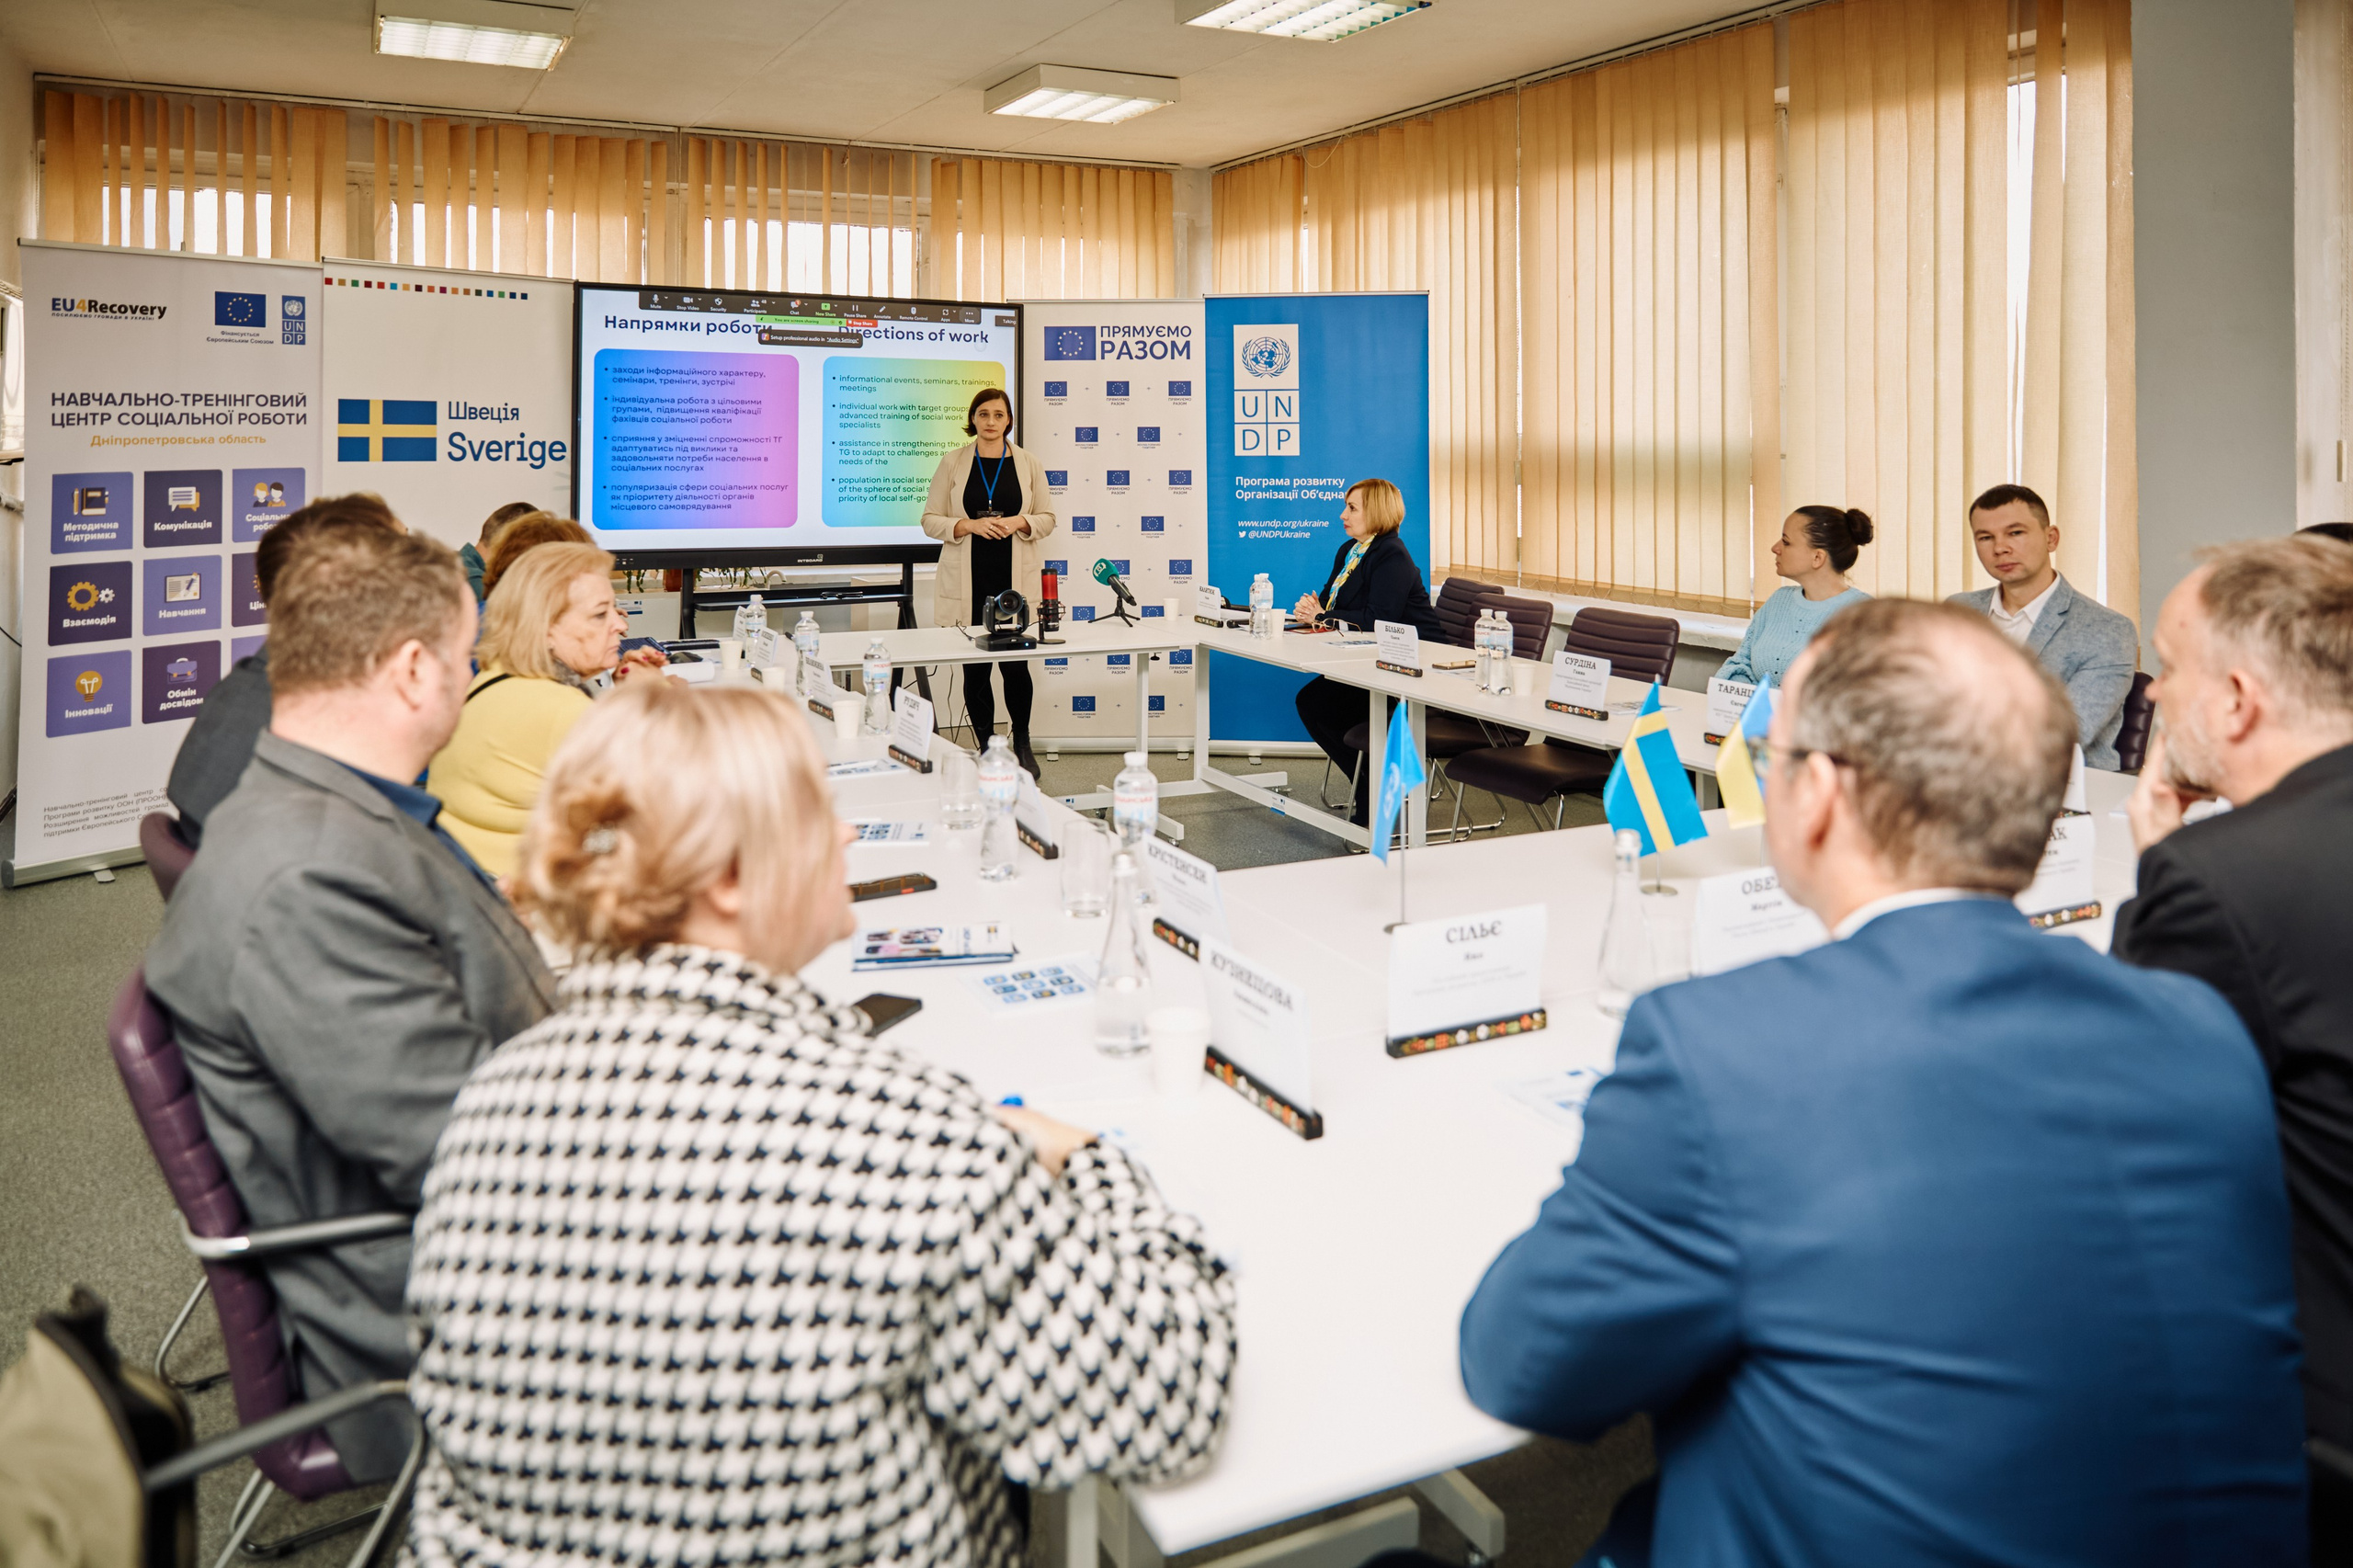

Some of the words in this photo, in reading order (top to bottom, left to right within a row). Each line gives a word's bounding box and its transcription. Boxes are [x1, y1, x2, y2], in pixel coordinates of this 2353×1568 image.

[51, 298, 167, 319] EU4Recovery
[605, 315, 700, 333] Напрямки
[928, 328, 945, 342] of
[949, 331, 989, 344] work
[1100, 325, 1192, 338] ПРЯМУЄМО
[1100, 340, 1190, 360] РАЗОМ
[646, 367, 717, 377] інформаційного
[719, 369, 767, 379] характеру,
[612, 377, 657, 385] семінари,
[659, 377, 699, 386] тренінги,
[839, 375, 892, 383] informational
[923, 378, 961, 386] seminars,
[961, 379, 996, 387] trainings,
[839, 384, 877, 392] meetings
[51, 392, 307, 407] НАВЧАЛЬНО-ТРЕНІНГОВИЙ
[612, 395, 675, 405] індивідуальна
[677, 396, 709, 406] робота
[718, 397, 762, 406] цільовими
[448, 401, 519, 424] Швеція
[612, 406, 653, 415] групами,
[656, 406, 710, 415] підвищення
[711, 407, 762, 415] кваліфікації
[918, 404, 941, 413] target
[51, 413, 111, 428] ЦЕНТР
[118, 410, 233, 427] СОЦІАЛЬНОЇ
[238, 413, 307, 426] РОБОТИ
[612, 415, 649, 424] фахівців
[651, 415, 699, 424] соціальної
[700, 416, 733, 425] роботи
[880, 413, 910, 421] training
[839, 421, 881, 429] specialists
[90, 435, 215, 448] Дніпропетровська
[219, 434, 267, 444] область
[665, 435, 708, 444] зміцненні
[709, 436, 771, 445] спроможності
[892, 440, 946, 449] strengthening
[448, 431, 567, 470] Sverige
[611, 445, 674, 453] адаптуватись
[676, 445, 688, 453] під
[897, 449, 938, 458] challenges
[676, 454, 713, 463] потреби
[611, 464, 663, 472] соціальних
[664, 465, 704, 473] послугах
[611, 483, 677, 492] популяризація
[679, 483, 708, 492] сфери
[710, 483, 758, 492] соціальних
[1235, 476, 1290, 487] Програма
[1293, 477, 1346, 488] розвитку
[864, 485, 891, 494] sphere
[623, 493, 673, 502] пріоритету
[675, 493, 721, 502] діяльності
[722, 493, 755, 501] органів
[838, 494, 867, 503] priority
[1235, 490, 1299, 501] Організації
[611, 503, 657, 512] місцевого
[658, 504, 732, 512] самоврядування
[63, 521, 119, 531] Методична
[153, 520, 212, 531] Комунікація
[1238, 519, 1329, 528] www.undp.org/ukraine
[64, 530, 117, 543] підтримка
[1248, 530, 1311, 539] @UNDPUkraine
[159, 607, 206, 619] Навчання
[63, 615, 116, 628] Взаємодія
[1564, 656, 1597, 670] СУРДІНА
[167, 687, 197, 699] Обмін
[159, 697, 204, 710] досвідом
[64, 704, 113, 719] Інновації
[44, 794, 128, 812] Навчально-тренінговий
[117, 800, 133, 808] ООН
